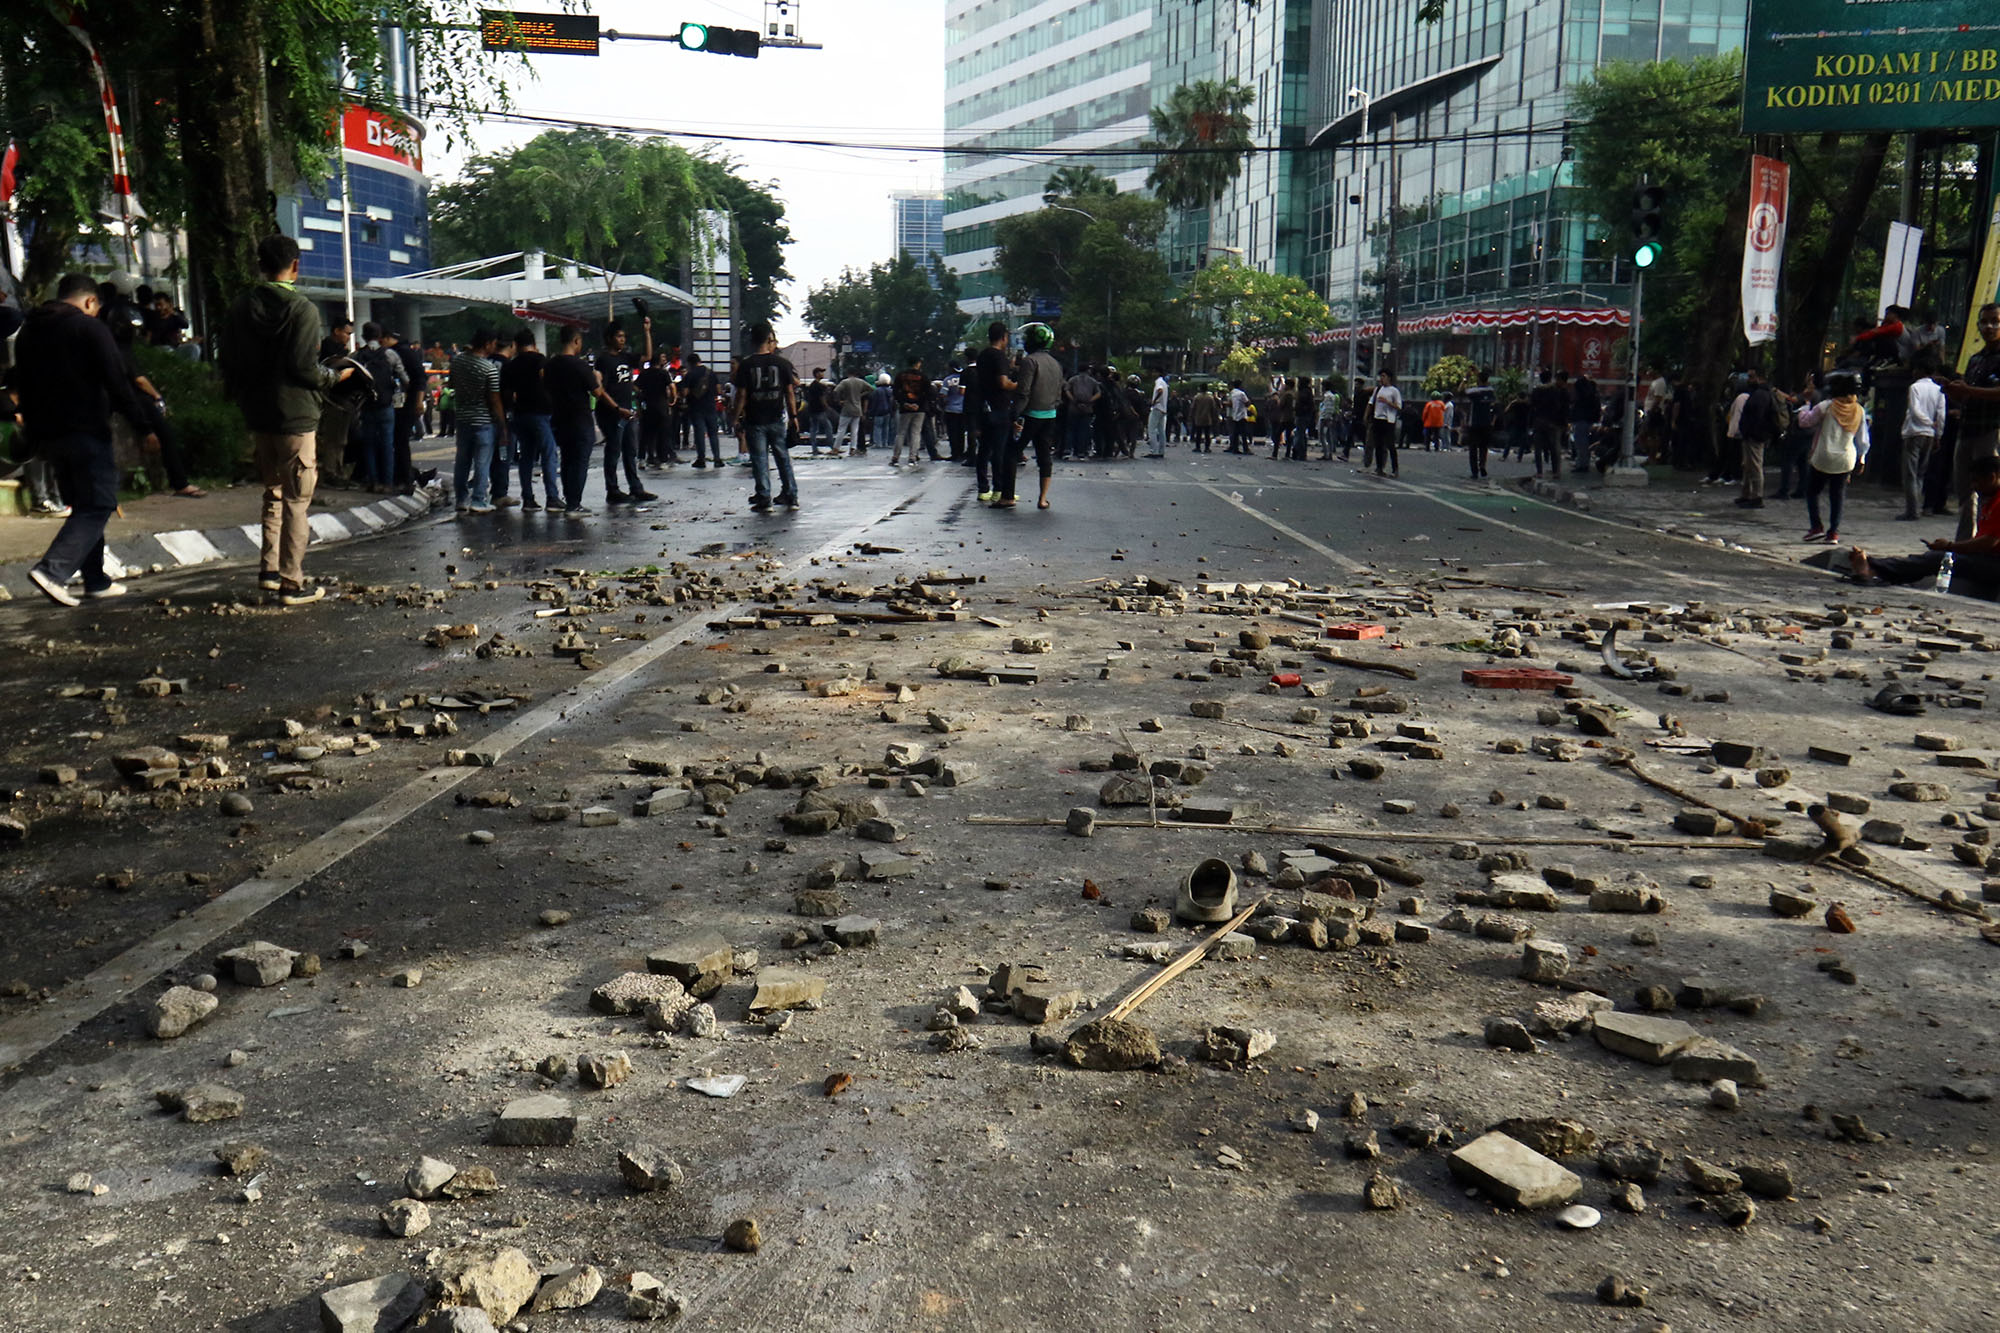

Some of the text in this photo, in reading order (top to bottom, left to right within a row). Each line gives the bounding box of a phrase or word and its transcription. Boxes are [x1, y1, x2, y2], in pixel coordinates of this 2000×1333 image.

[1815, 52, 1921, 77] KODAM
[1961, 48, 1998, 72] BB
[1766, 84, 1862, 108] KODIM
[1868, 82, 1921, 103] 0201
